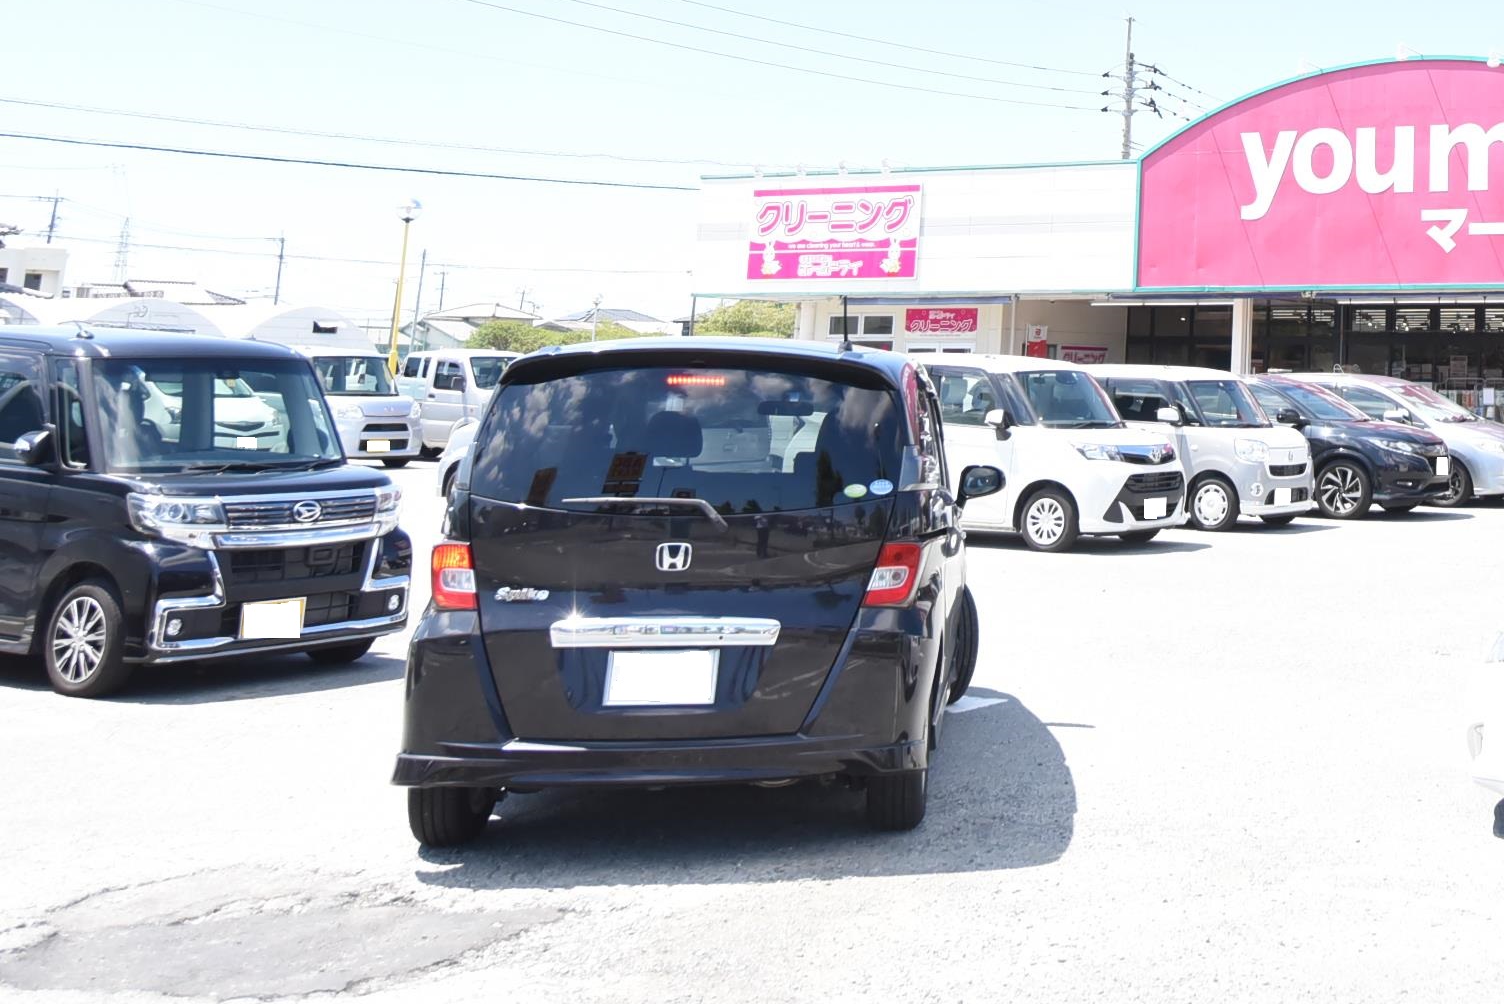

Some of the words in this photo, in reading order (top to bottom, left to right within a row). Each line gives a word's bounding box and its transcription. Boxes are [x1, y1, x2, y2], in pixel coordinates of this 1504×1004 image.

[758, 196, 913, 235] クリーニング
[910, 318, 973, 333] クリーニング
[494, 586, 550, 602] Spike
